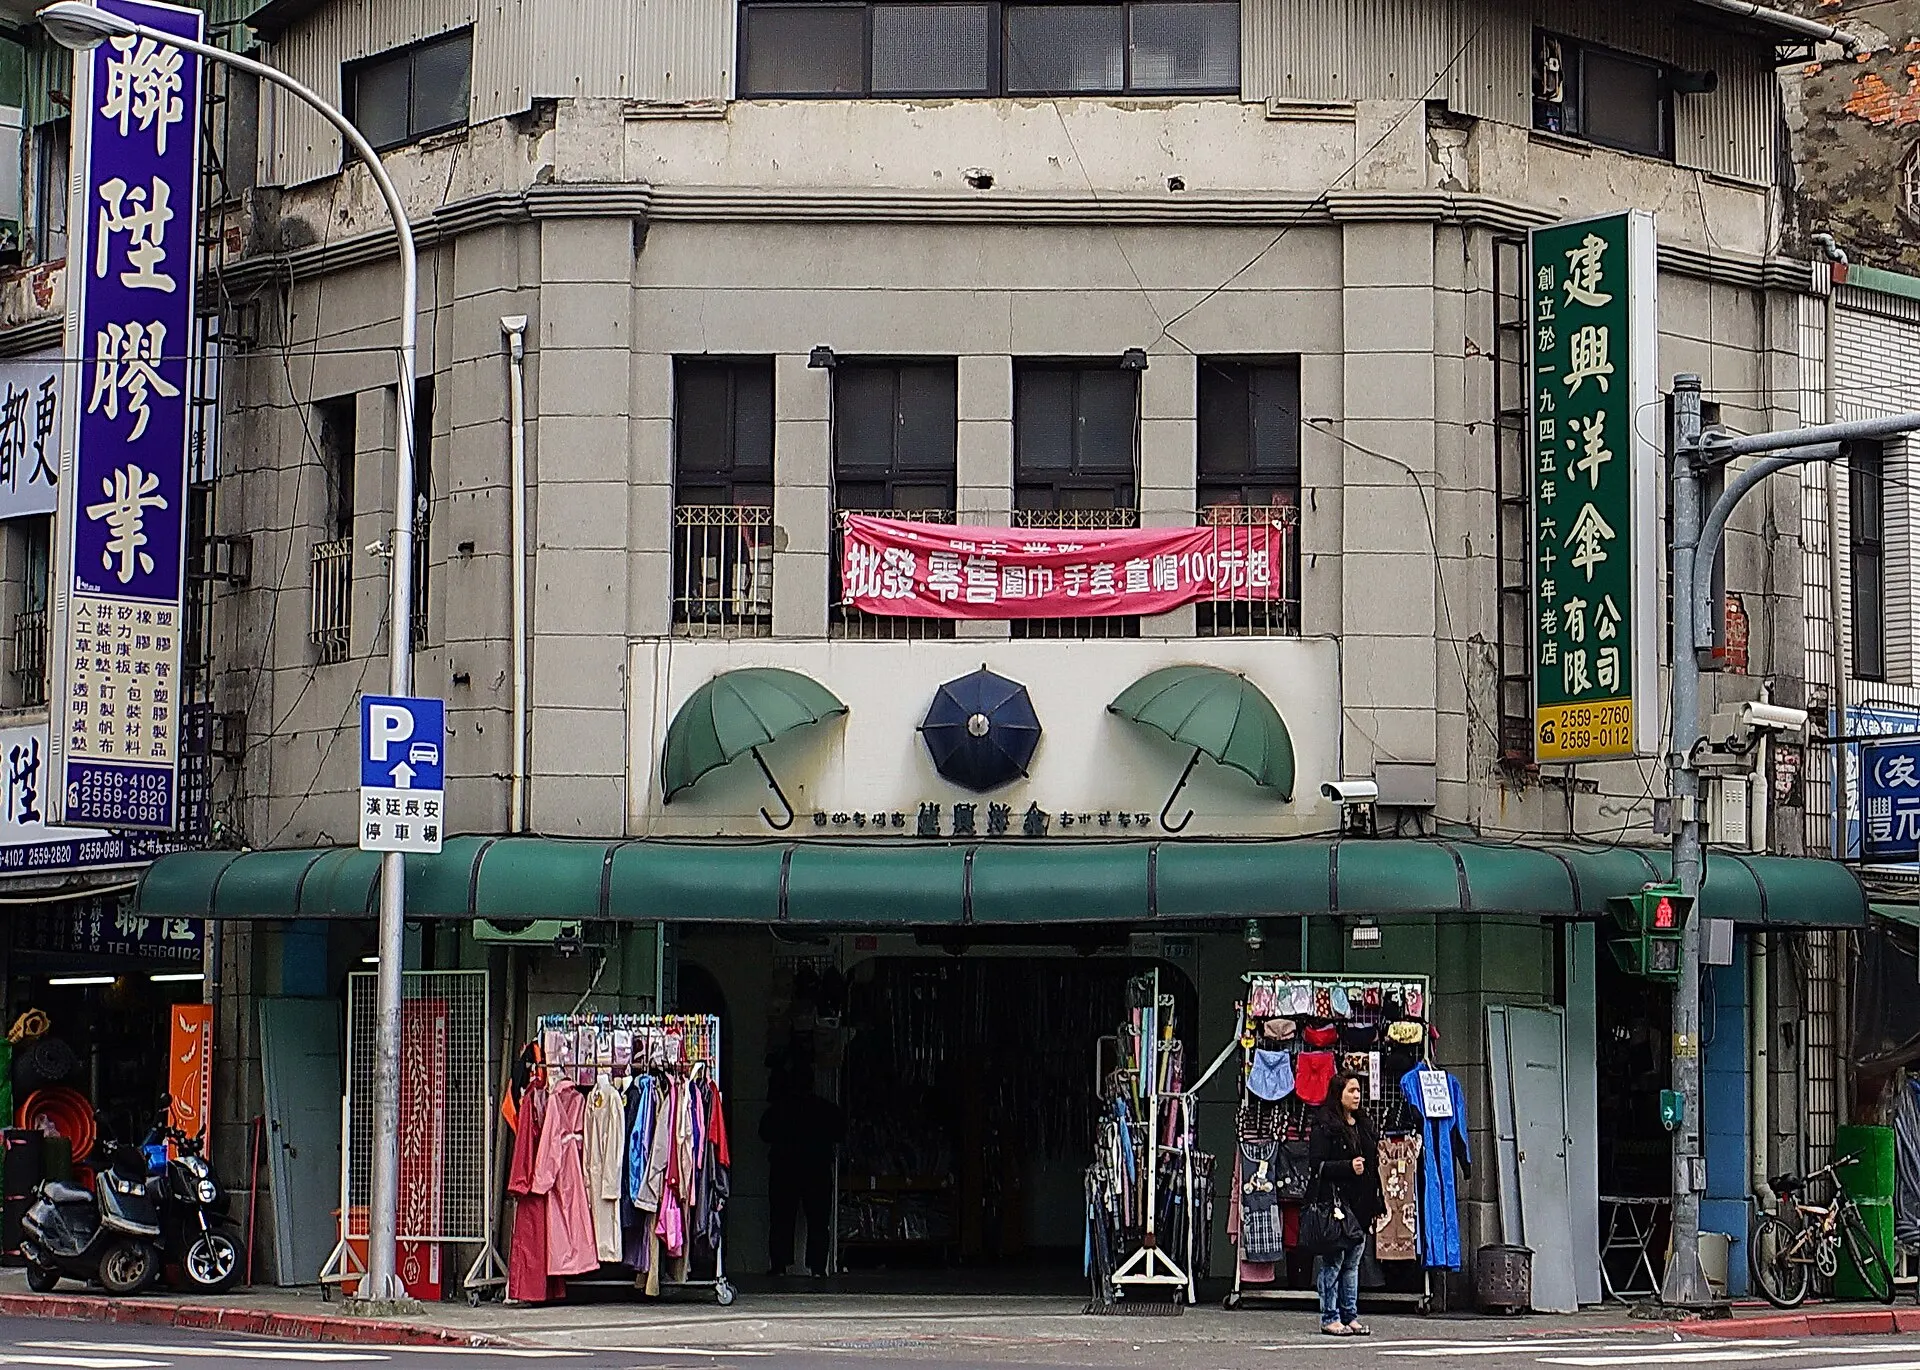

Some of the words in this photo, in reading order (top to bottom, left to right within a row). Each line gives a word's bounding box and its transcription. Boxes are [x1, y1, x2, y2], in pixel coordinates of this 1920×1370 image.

[87, 36, 184, 584] 聯陞膠業
[1538, 265, 1556, 505] 創立於一九四五年
[1562, 232, 1617, 583] 建興洋傘
[1540, 516, 1558, 666] 六十年老店
[369, 704, 415, 762] P
[1561, 705, 1630, 728] 2559-2760
[1561, 726, 1629, 750] 2559-0112
[366, 797, 439, 818] 漢廷長安
[107, 941, 135, 956] TEL
